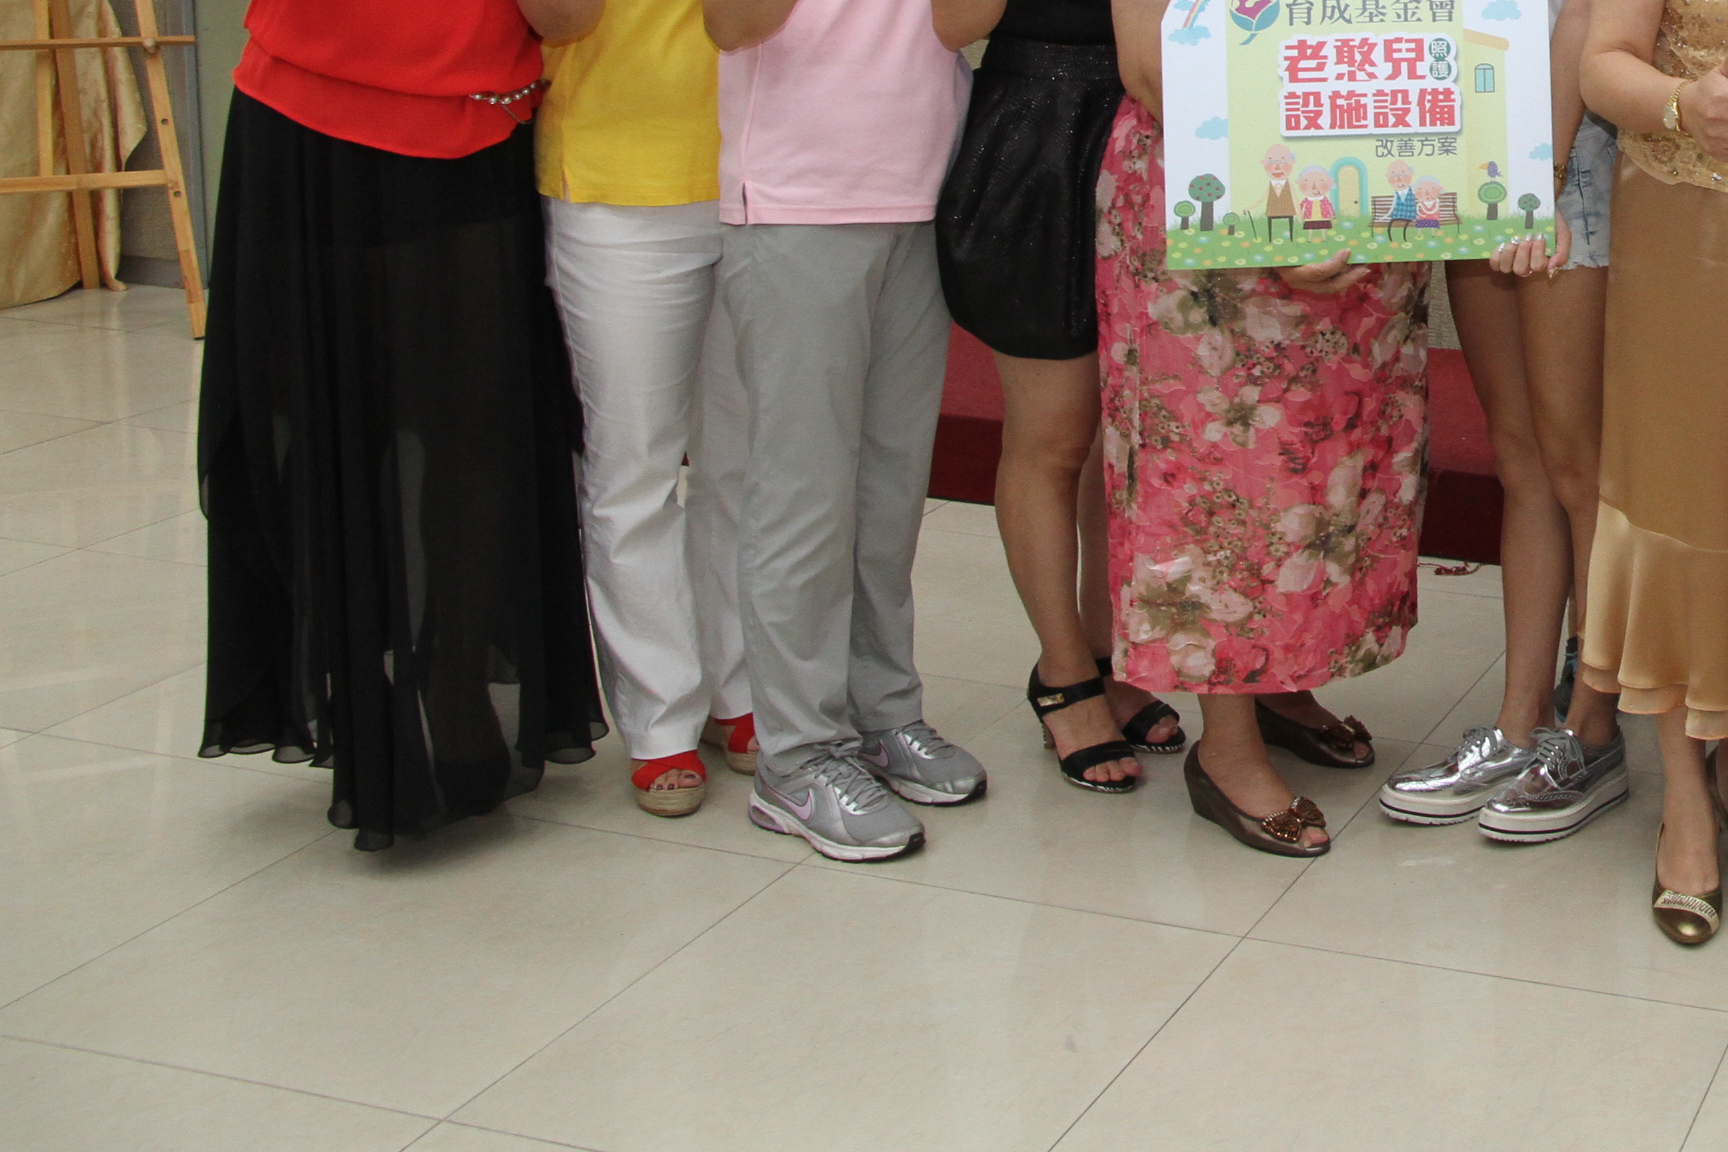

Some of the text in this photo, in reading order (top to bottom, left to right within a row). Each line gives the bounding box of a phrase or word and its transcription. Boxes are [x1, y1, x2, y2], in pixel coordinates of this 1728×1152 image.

[1283, 36, 1427, 84] 老憨兒
[1429, 38, 1451, 80] 照護
[1284, 87, 1457, 132] 設施設備
[1375, 135, 1458, 158] 改善方案
